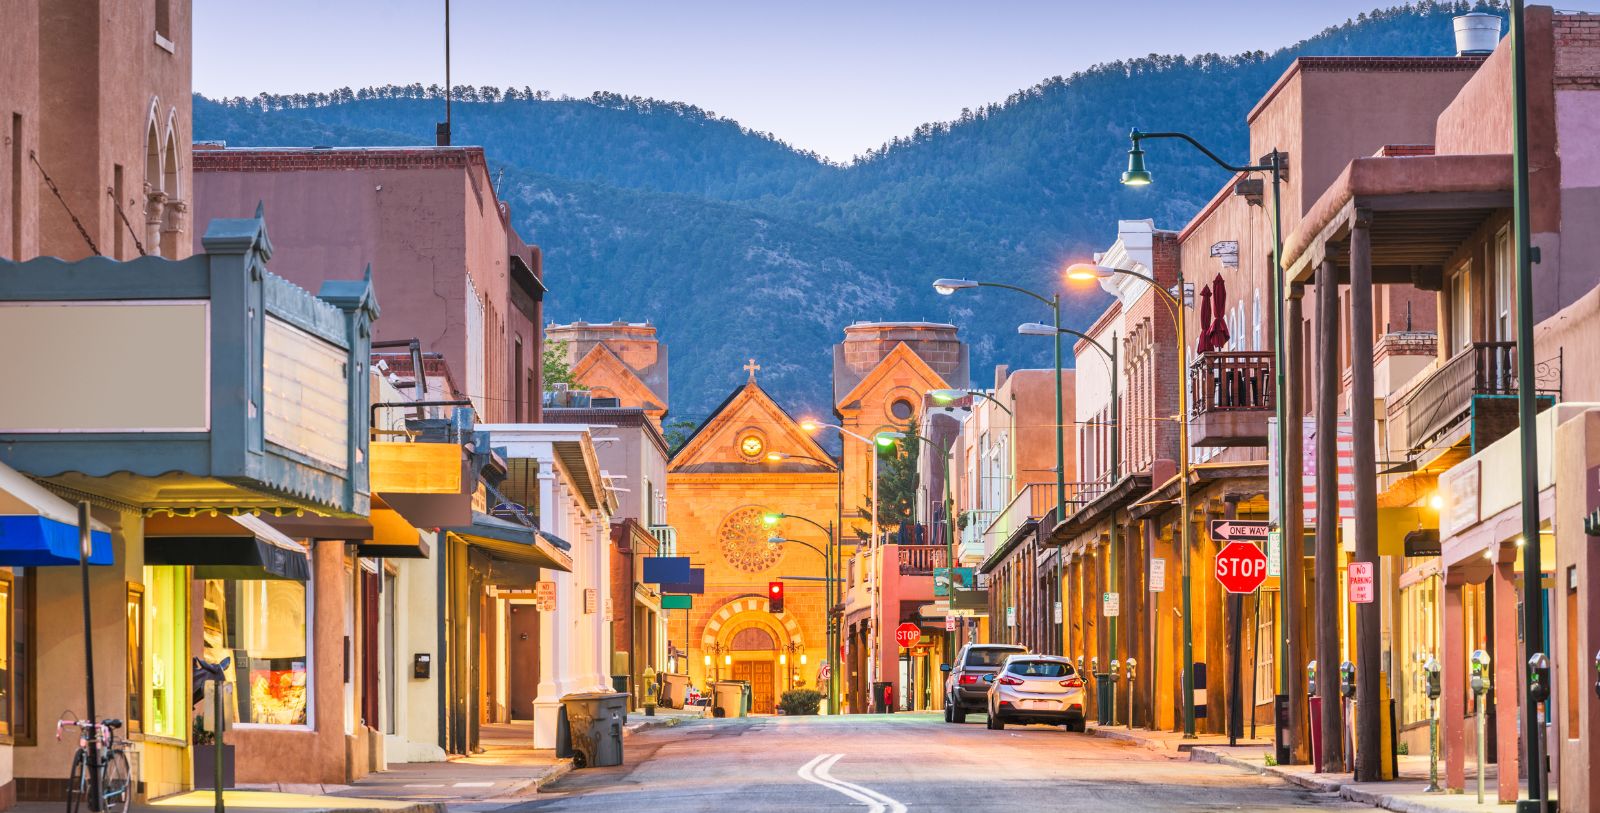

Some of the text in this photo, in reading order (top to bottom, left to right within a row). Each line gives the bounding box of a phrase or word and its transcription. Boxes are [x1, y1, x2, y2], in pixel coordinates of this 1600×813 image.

[1229, 526, 1267, 535] ONE WAY
[1217, 557, 1266, 577] STOP
[1356, 566, 1366, 575] NO
[1350, 576, 1373, 585] PARKING
[896, 630, 919, 640] STOP
